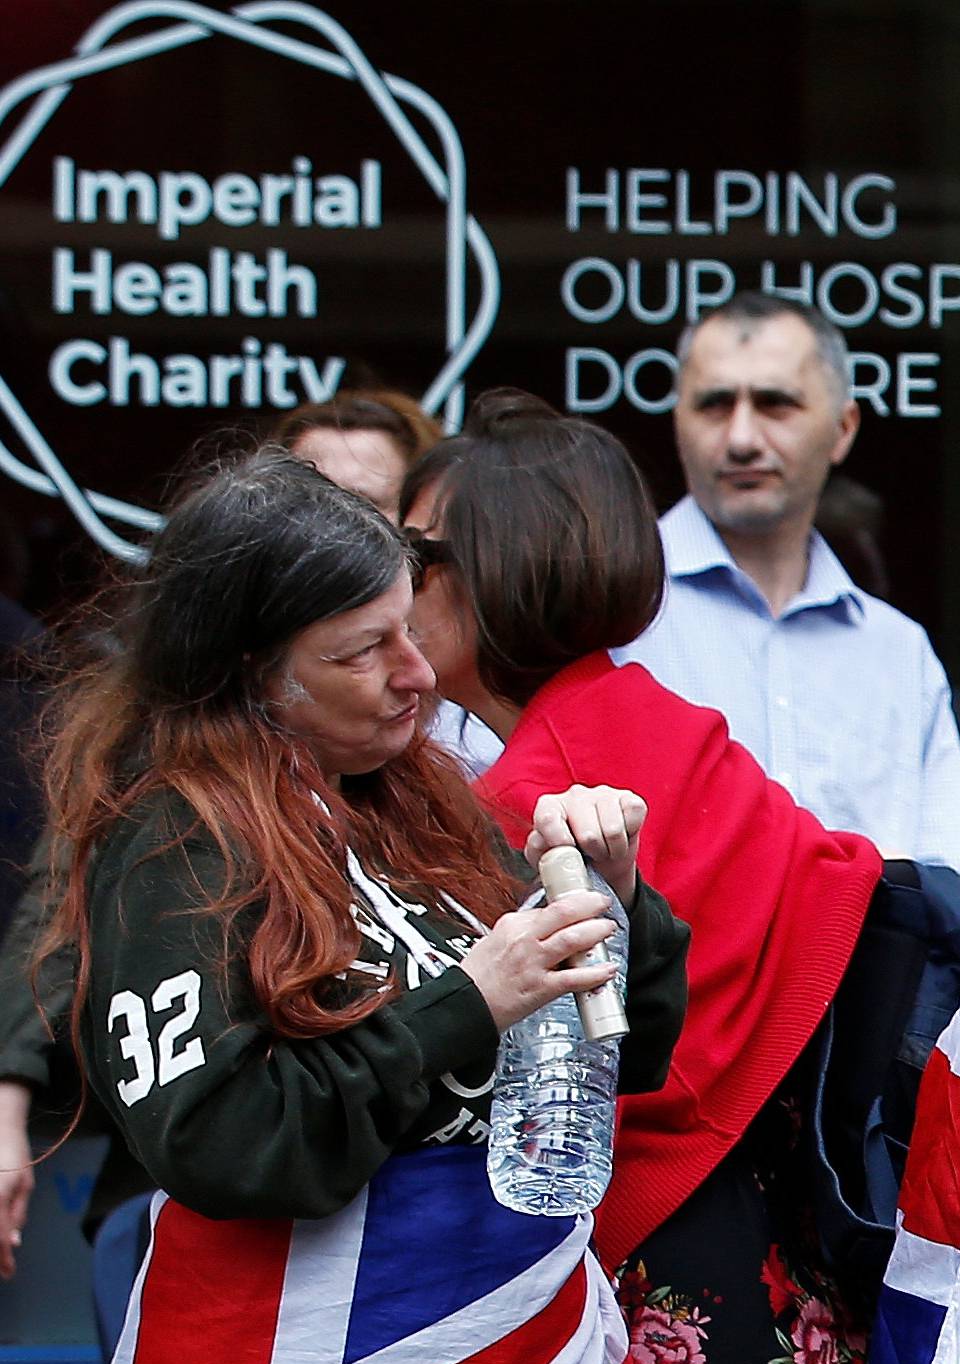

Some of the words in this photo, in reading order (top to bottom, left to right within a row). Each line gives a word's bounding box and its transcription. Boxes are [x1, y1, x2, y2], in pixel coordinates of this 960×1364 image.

[53, 155, 382, 240] Imperial
[566, 166, 897, 240] HELPING
[53, 248, 318, 317] Health
[50, 336, 346, 409] Charity
[566, 347, 680, 414] DO
[107, 969, 206, 1108] 32
